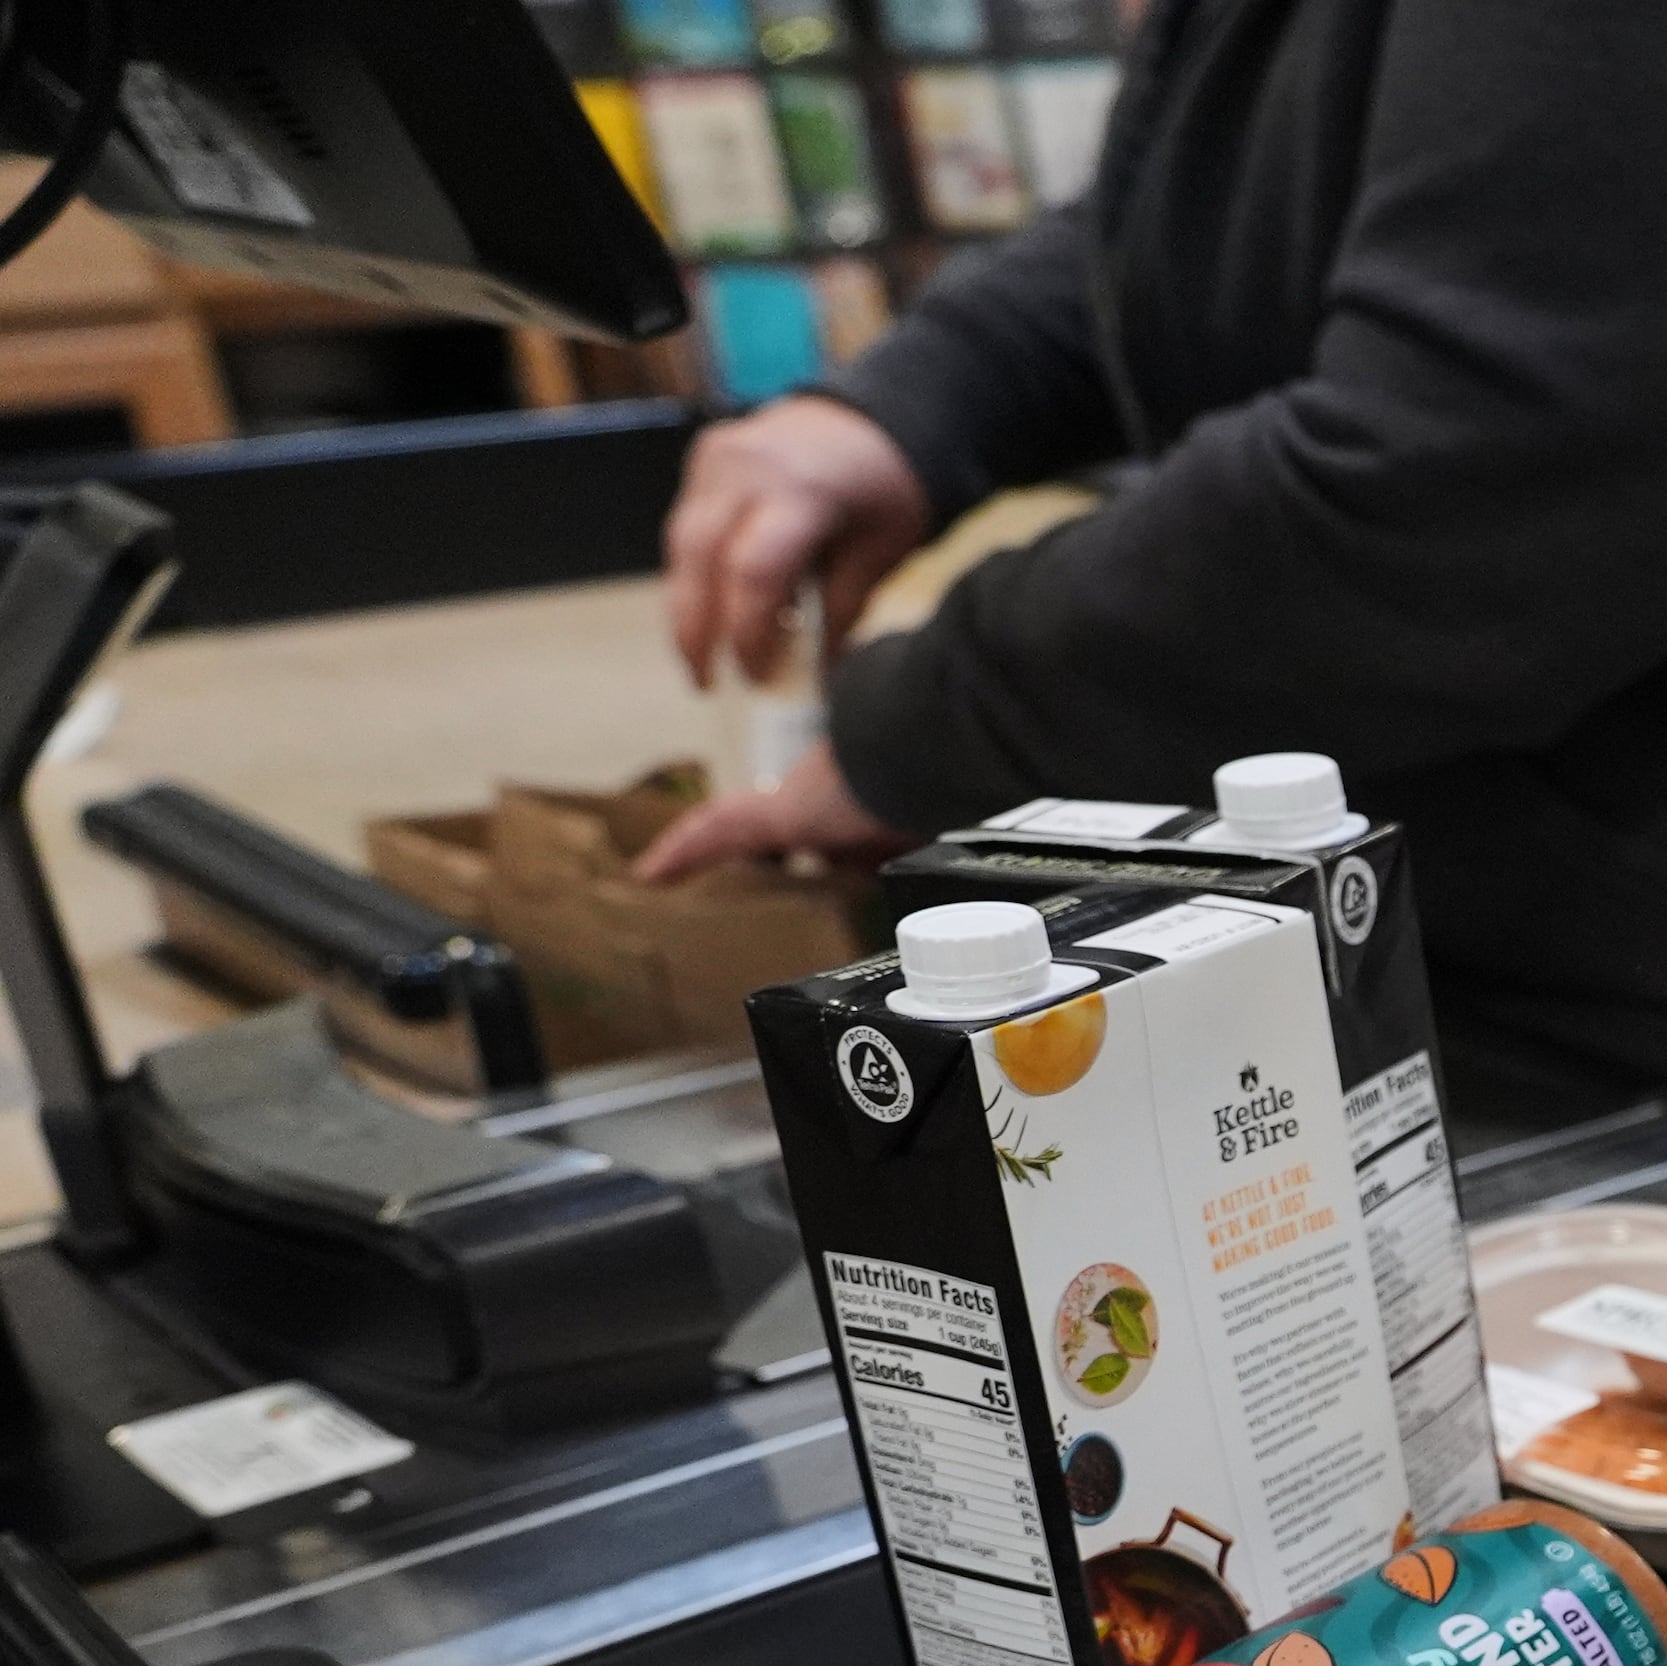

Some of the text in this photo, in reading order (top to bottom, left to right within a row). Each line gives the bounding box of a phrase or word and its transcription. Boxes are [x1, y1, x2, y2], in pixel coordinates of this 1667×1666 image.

[1213, 1086, 1295, 1136] Kettle
[1219, 1118, 1300, 1163] & Fire
[832, 1259, 994, 1316] Nutrition Facts
[840, 1307, 884, 1329] Serving
[887, 1316, 909, 1331] size
[850, 1354, 1010, 1409] Calories 45
